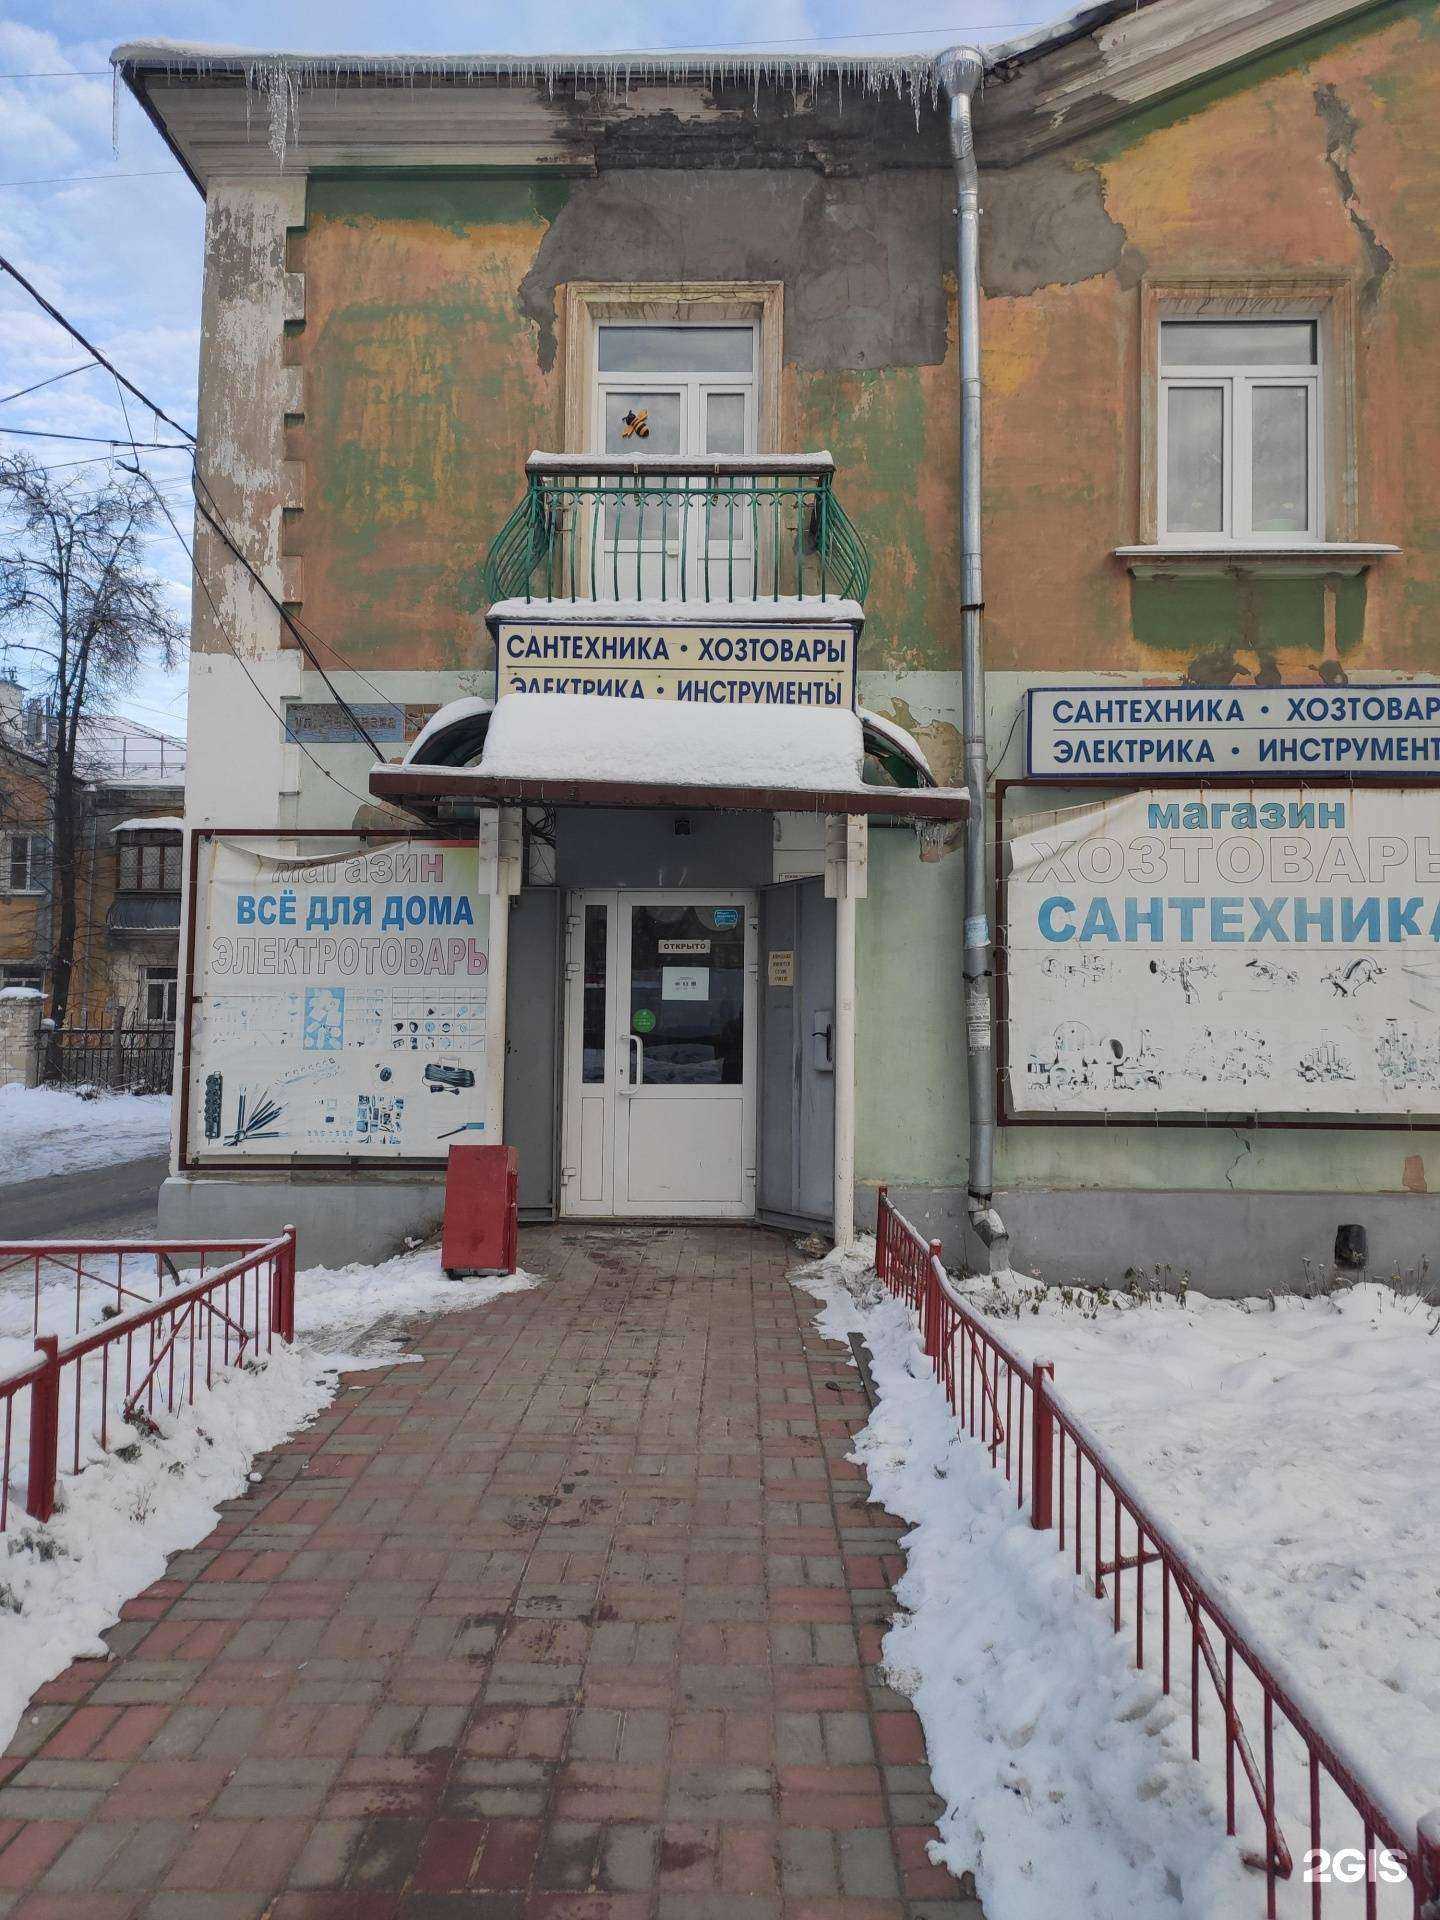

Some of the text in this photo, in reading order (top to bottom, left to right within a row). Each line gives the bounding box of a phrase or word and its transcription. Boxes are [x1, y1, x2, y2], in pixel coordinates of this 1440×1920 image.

[506, 635, 846, 662] САНТЕХНИКА ХОЗТОВАРЫ
[677, 679, 842, 705] ИНСТРУМЕНТЫ
[1053, 699, 1245, 724] САНТЕХНИКА
[1053, 739, 1215, 763] ЭЛЕКТРИКА
[1147, 802, 1346, 829] магазин
[236, 889, 474, 931] ВСЁ ДЛЯ ДОМА
